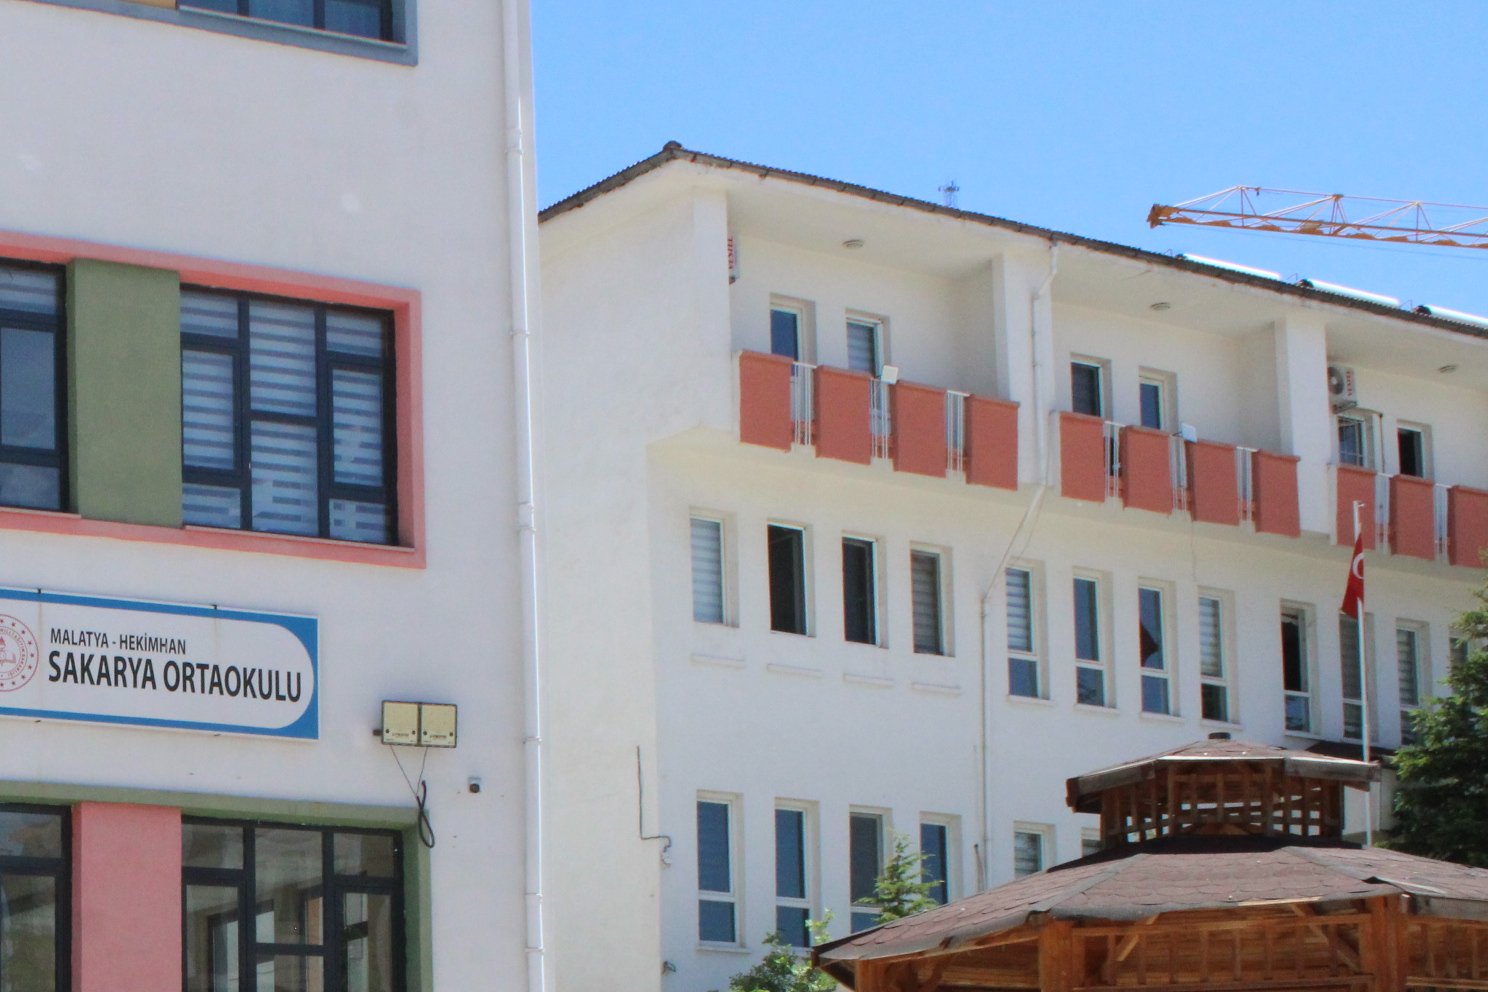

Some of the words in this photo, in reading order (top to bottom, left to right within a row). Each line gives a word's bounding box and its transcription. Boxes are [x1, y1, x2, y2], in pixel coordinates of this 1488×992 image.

[50, 627, 109, 649] MALATYA
[119, 632, 187, 655] HEKİMHAN
[48, 650, 157, 690] SAKARYA
[163, 660, 302, 703] ORTAOKULU
